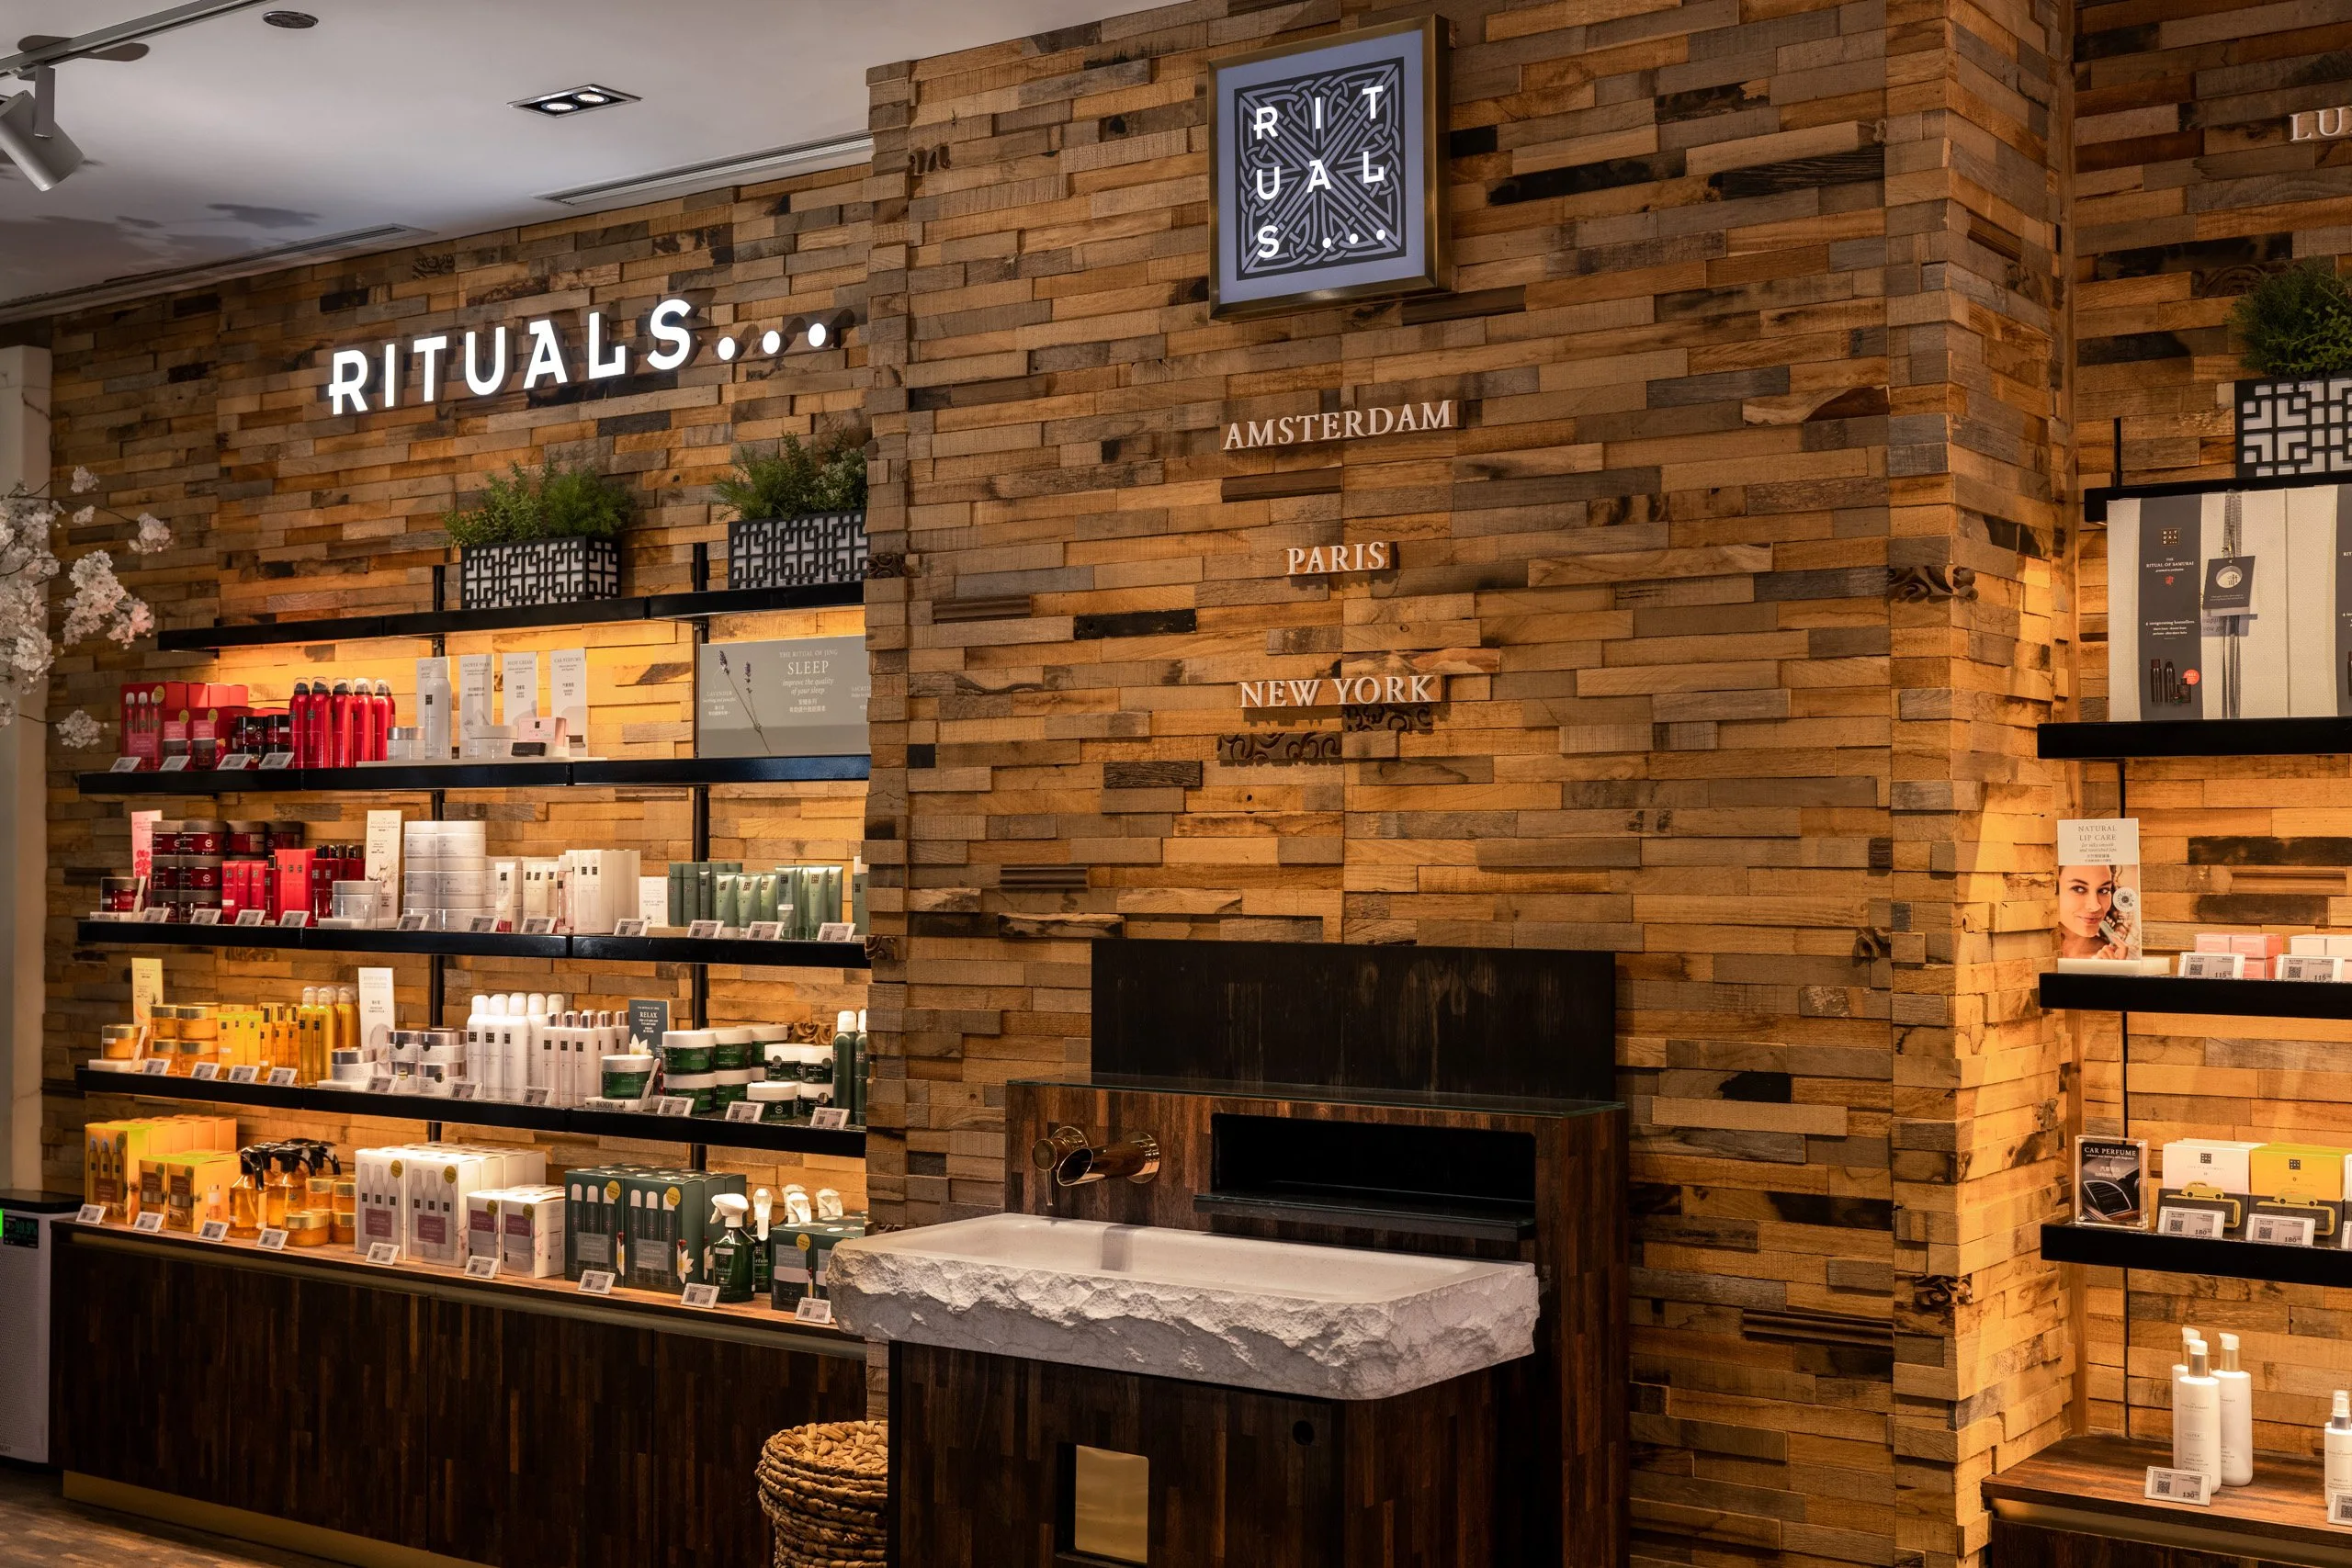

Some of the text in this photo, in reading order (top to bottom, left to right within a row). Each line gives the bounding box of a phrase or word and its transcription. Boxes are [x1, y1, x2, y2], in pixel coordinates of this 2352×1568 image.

[2289, 104, 2352, 141] LU
[1223, 400, 1453, 451] AMSTERDAM
[1287, 542, 1386, 576] PARIS
[787, 660, 830, 675] SLEEP
[1238, 675, 1436, 708] NEW YORK
[2101, 1147, 2137, 1156] PERFUME
